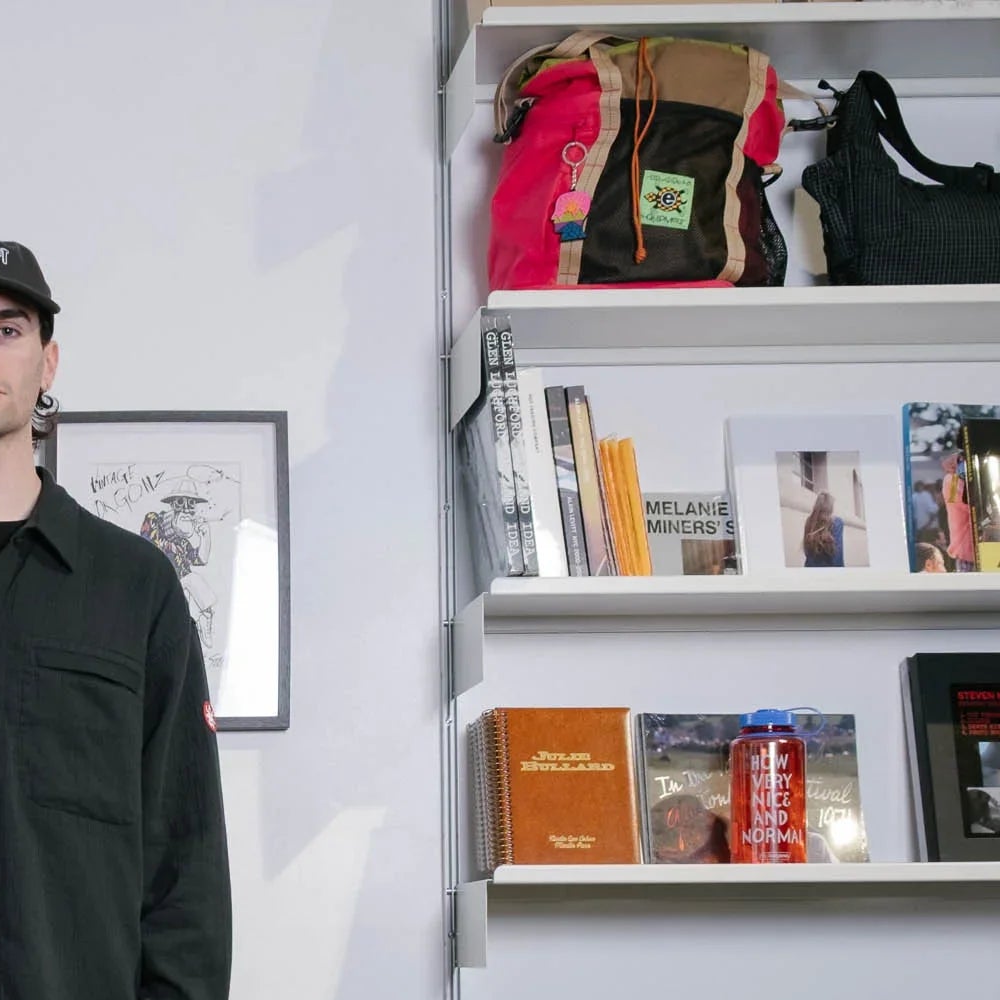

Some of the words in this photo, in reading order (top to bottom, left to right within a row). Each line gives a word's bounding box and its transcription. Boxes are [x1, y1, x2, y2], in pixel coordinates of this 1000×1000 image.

[486, 331, 499, 366] GLEN
[506, 522, 520, 557] IDEA
[501, 331, 514, 366] GLEN
[522, 522, 536, 557] IDEA
[646, 501, 729, 516] MELANIE
[647, 519, 720, 535] MINERS'
[957, 691, 995, 700] STEVEN
[520, 761, 616, 772] BULLARD
[751, 754, 788, 770] HOW
[752, 773, 792, 789] VERY
[752, 792, 791, 807] NICE
[754, 810, 788, 826] AND
[742, 828, 802, 844] NORMAL
